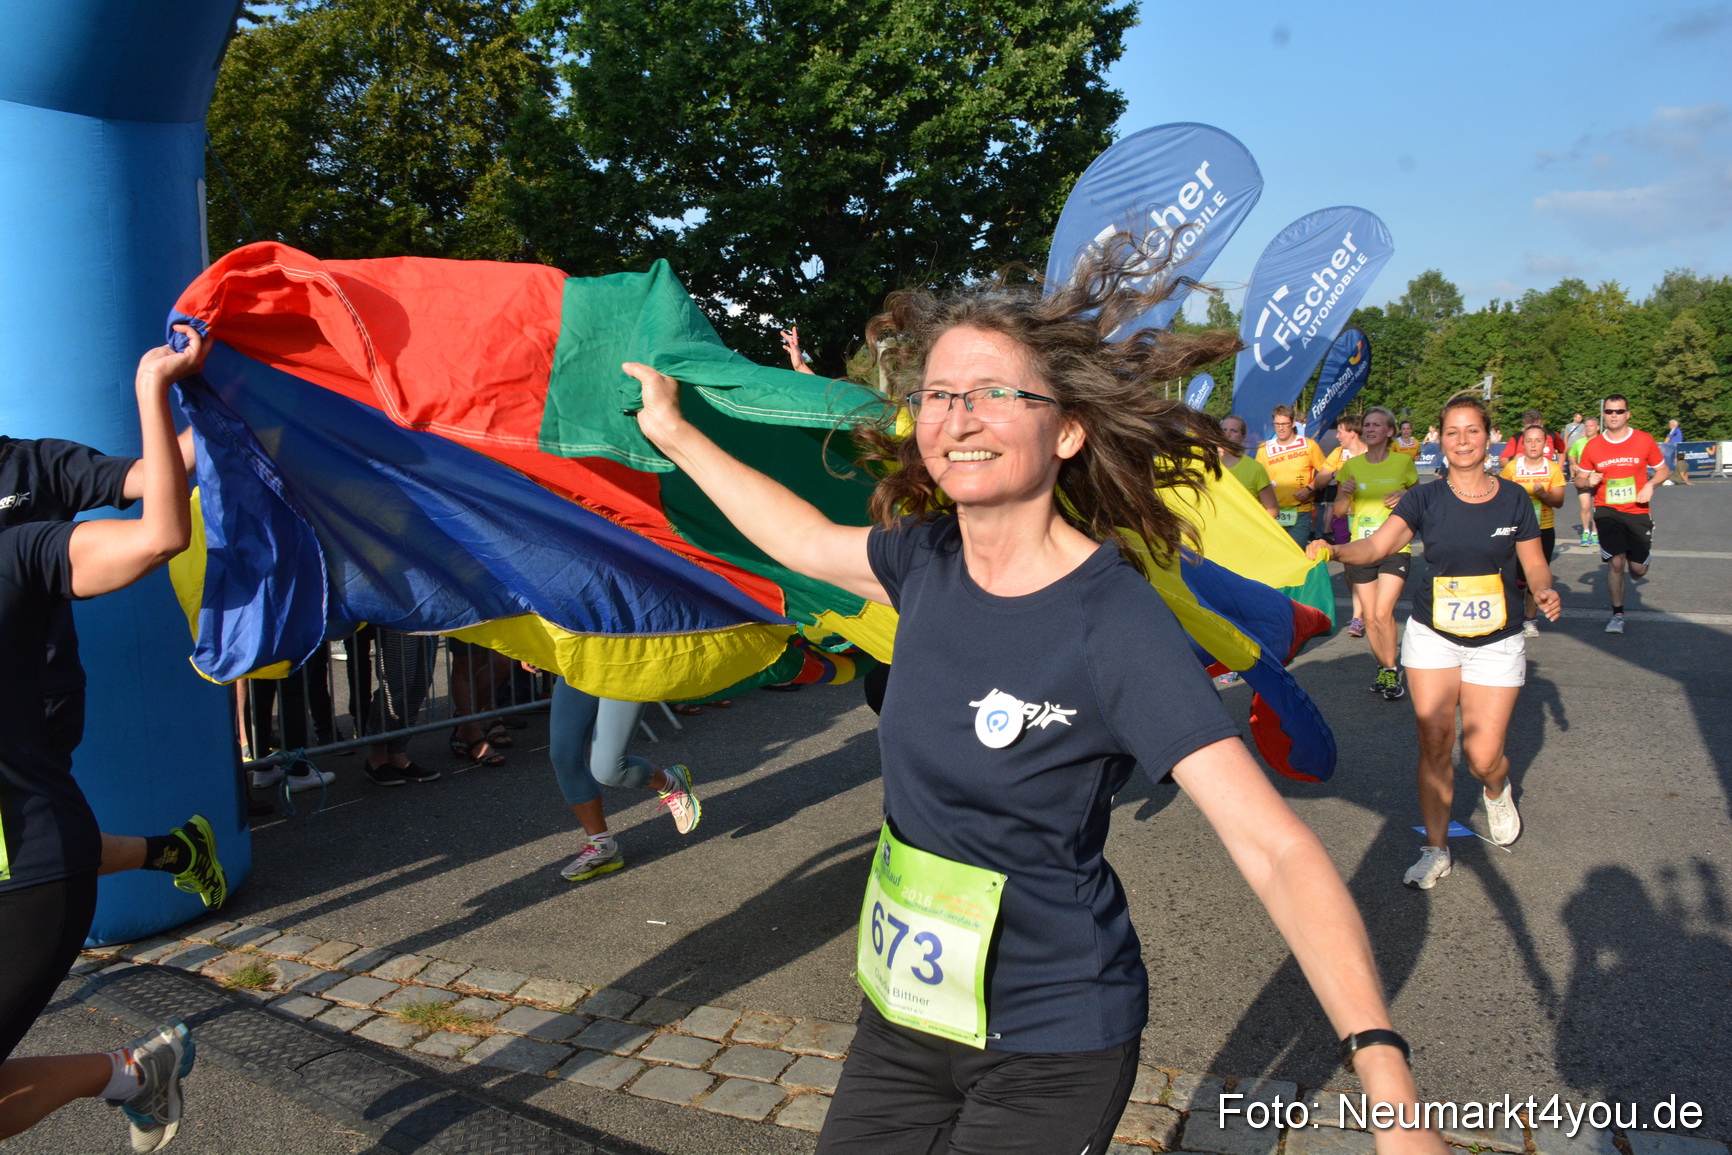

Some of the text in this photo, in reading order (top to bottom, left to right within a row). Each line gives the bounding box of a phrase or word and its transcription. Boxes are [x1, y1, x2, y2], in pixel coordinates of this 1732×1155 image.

[1272, 231, 1358, 352] Fischer
[1301, 252, 1368, 350] AUTOMOBILE
[1268, 450, 1309, 466] MAX BÖGL
[1597, 457, 1633, 468] NEUMARKT
[1608, 487, 1633, 497] 1411
[1447, 600, 1491, 621] 748
[901, 885, 933, 908] 2016
[871, 900, 945, 987] 673
[892, 986, 931, 1007] Bittner
